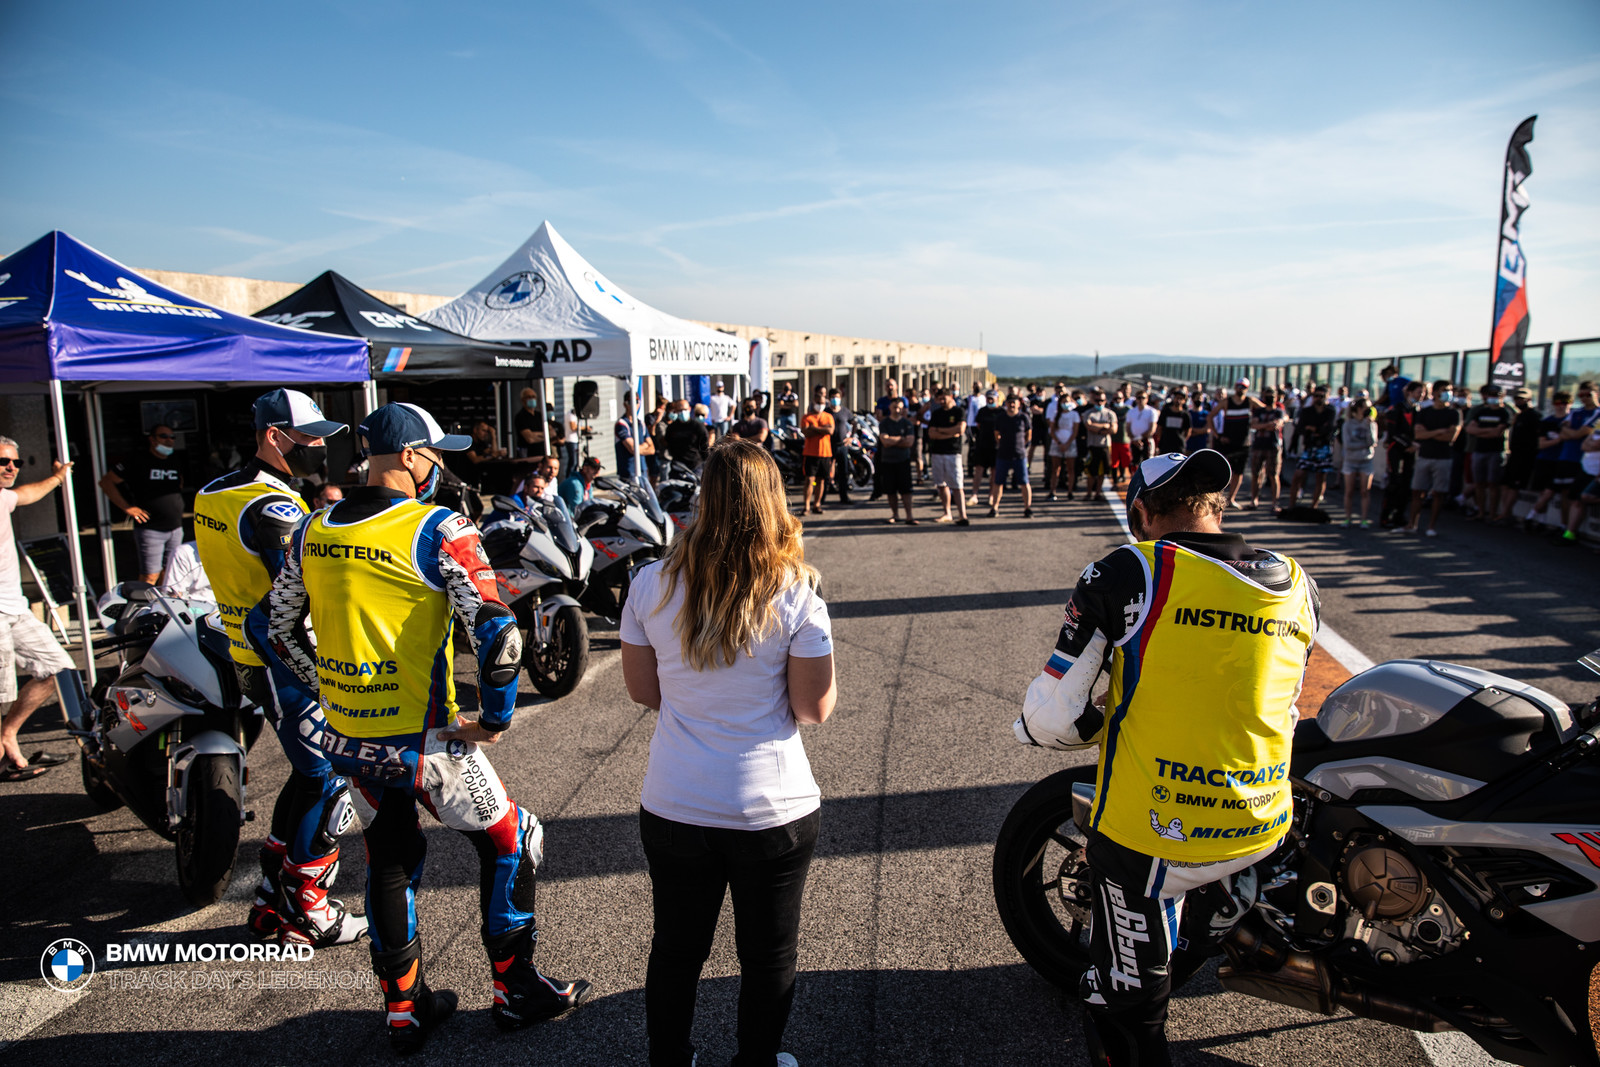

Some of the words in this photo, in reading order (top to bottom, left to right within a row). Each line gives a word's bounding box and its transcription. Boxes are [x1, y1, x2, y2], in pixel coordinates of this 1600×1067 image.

[92, 301, 223, 320] MICHELIN
[649, 338, 679, 361] BMW
[684, 340, 739, 362] MOTORRAD
[150, 469, 178, 480] BMC
[1174, 607, 1300, 637] INSTRUCTEUR
[337, 681, 399, 694] MOTORRAD
[331, 702, 400, 718] MICHELIN
[320, 730, 410, 765] ALEX
[465, 755, 488, 787] MOTO
[482, 787, 500, 815] RIDE
[1155, 757, 1287, 789] TRACKDAYS
[461, 768, 493, 822] TOULOUSE
[1175, 792, 1218, 808] BMW
[1221, 790, 1281, 810] MOTORRA
[1190, 810, 1288, 839] MICHELIN
